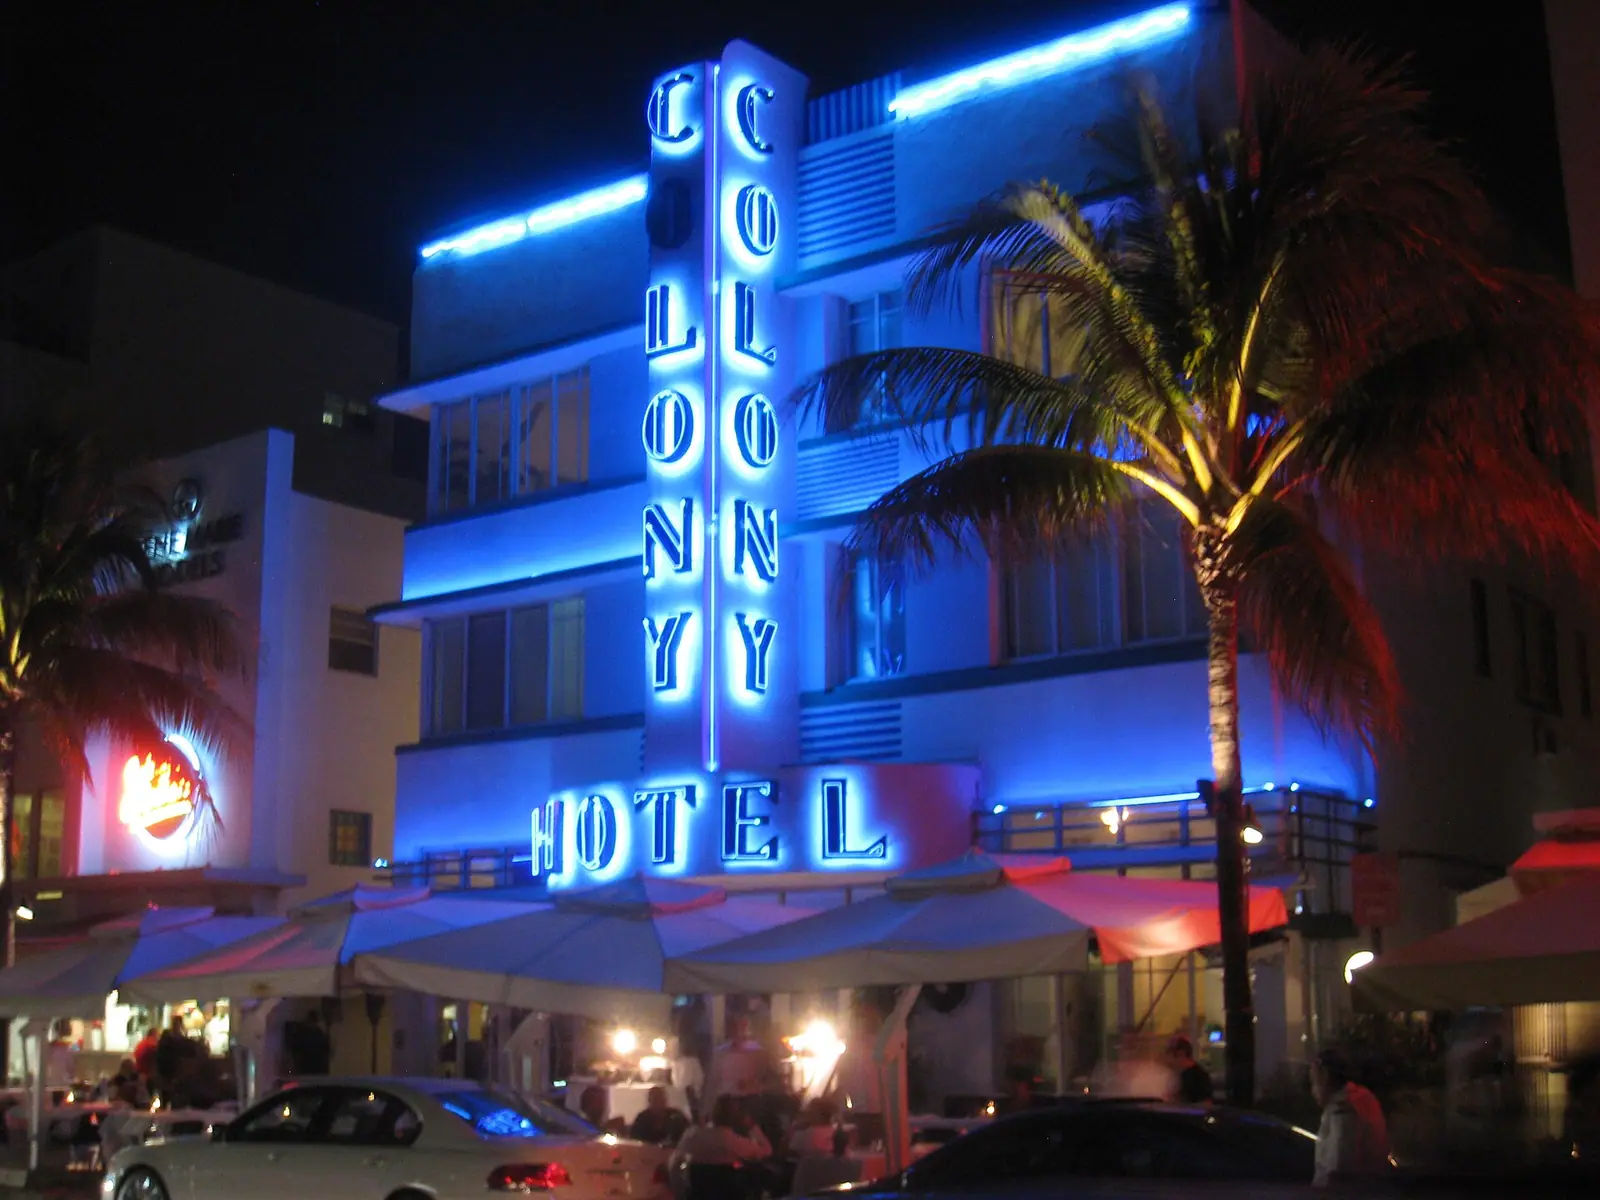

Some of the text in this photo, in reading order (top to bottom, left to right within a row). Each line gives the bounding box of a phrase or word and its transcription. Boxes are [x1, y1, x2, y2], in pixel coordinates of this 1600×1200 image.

[642, 72, 697, 693] COLONY
[734, 83, 779, 694] COLONY
[530, 778, 888, 878] HOTEL
